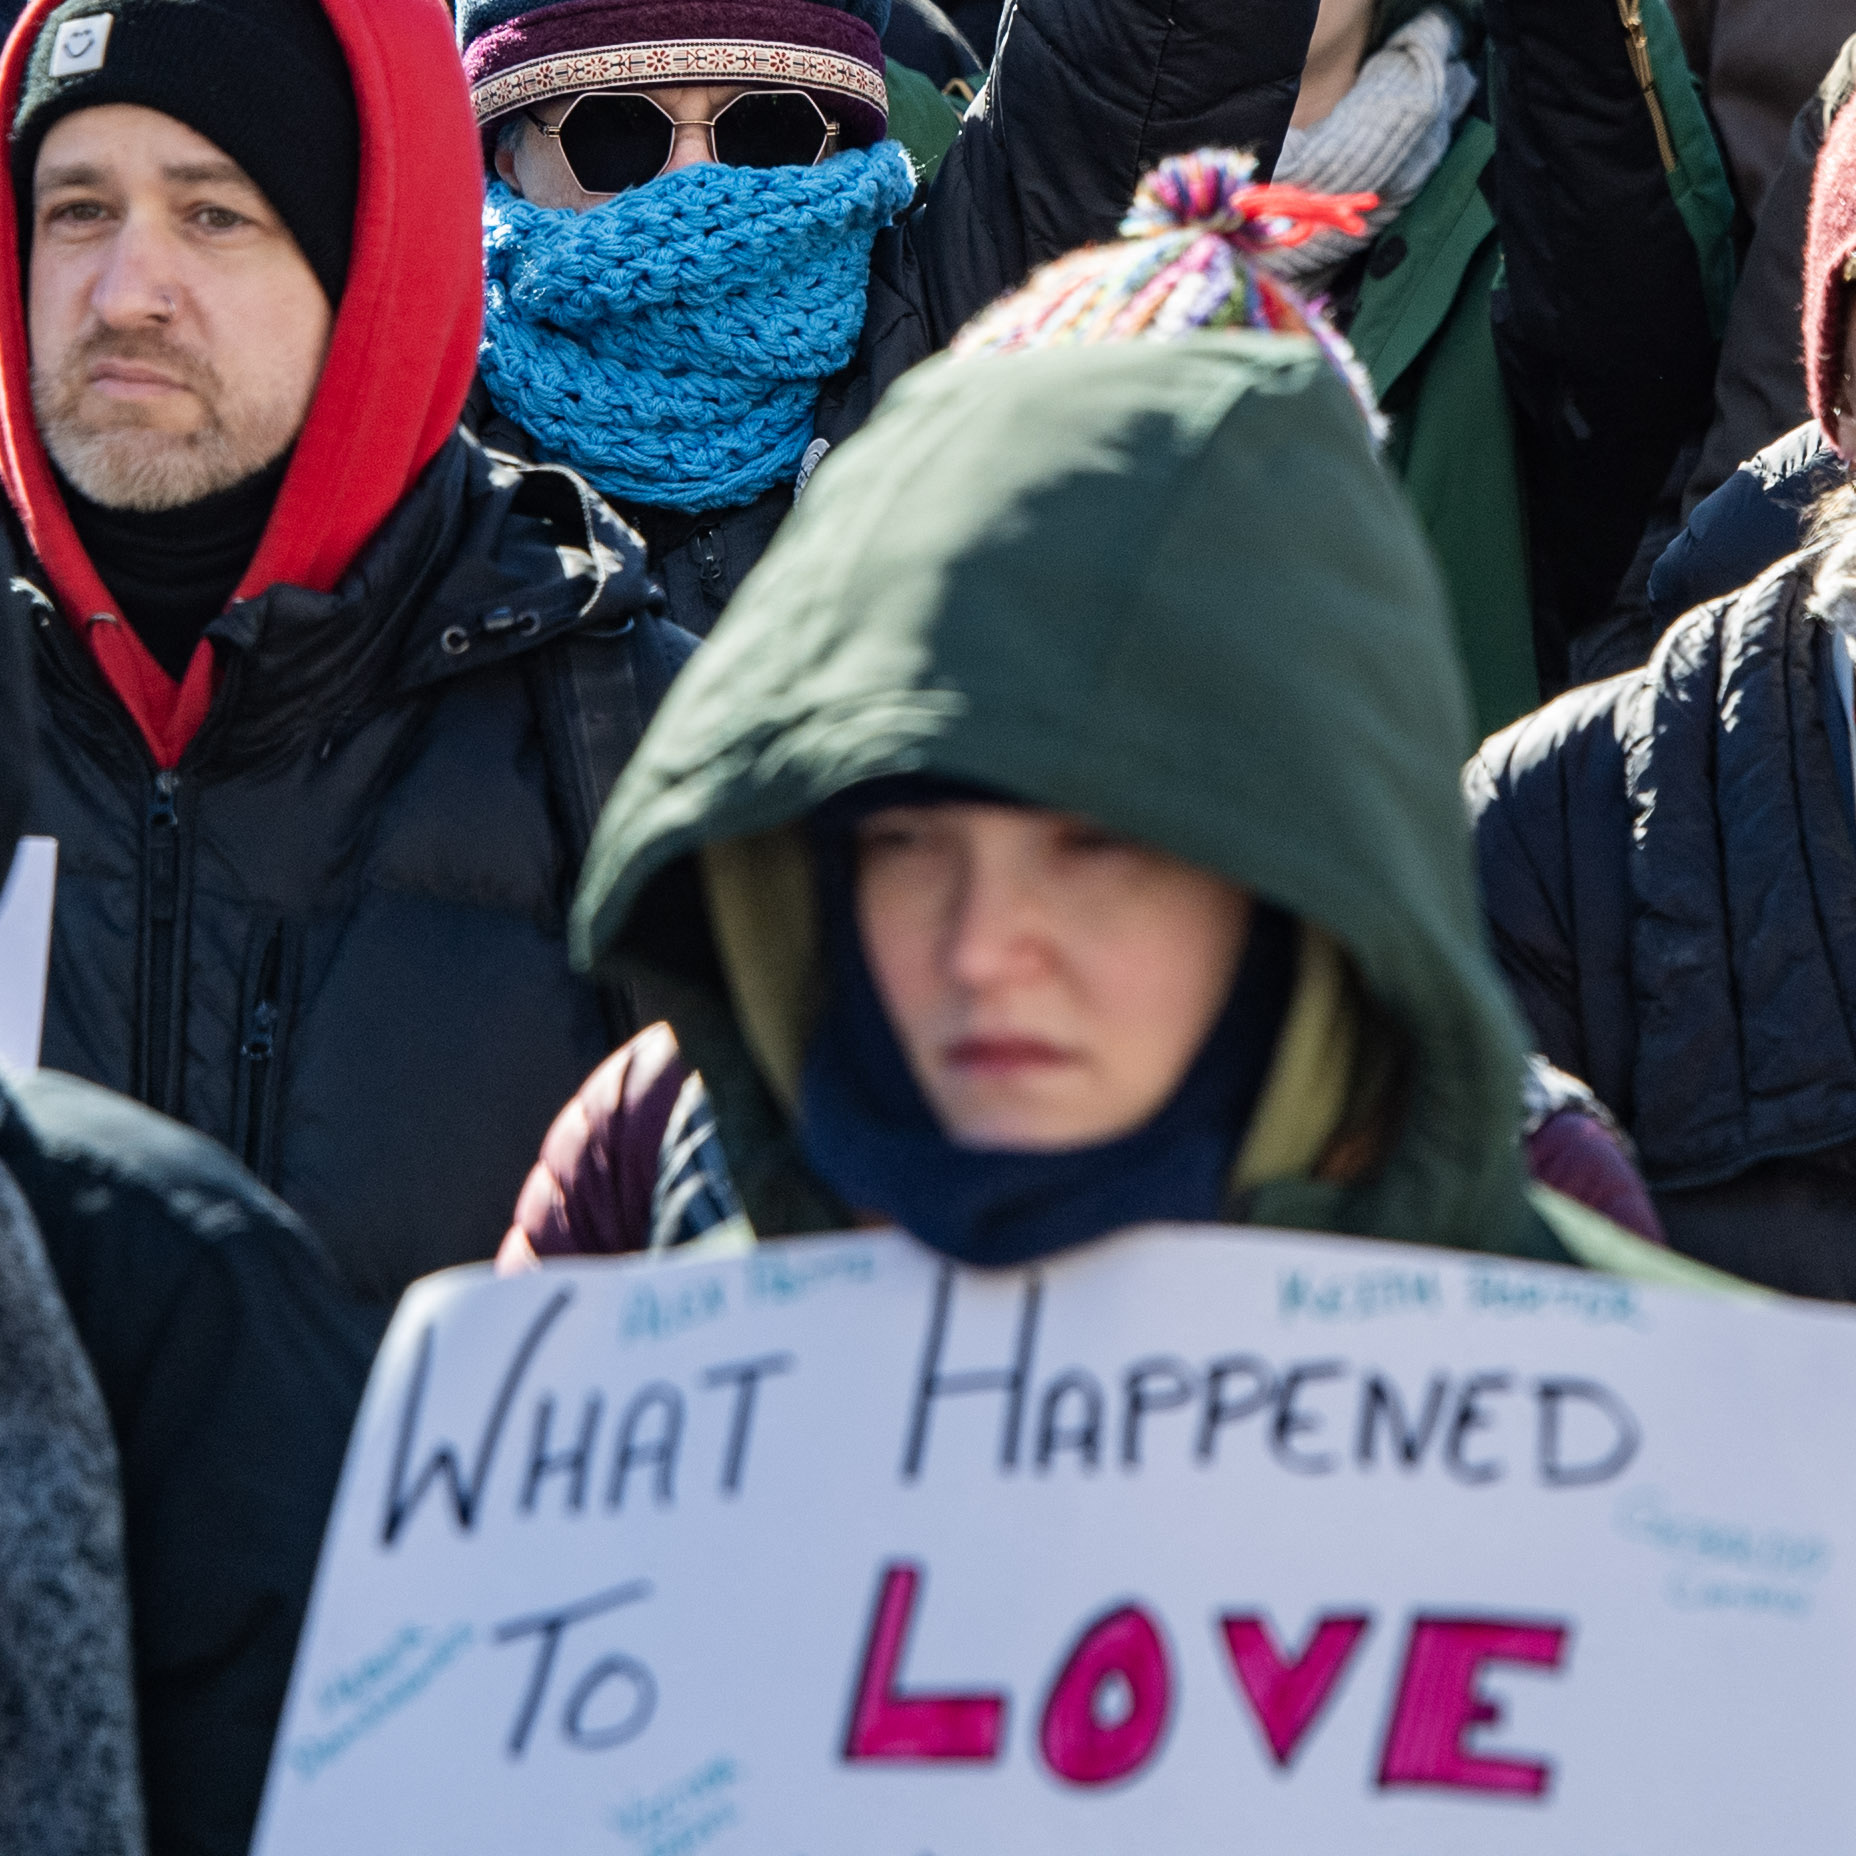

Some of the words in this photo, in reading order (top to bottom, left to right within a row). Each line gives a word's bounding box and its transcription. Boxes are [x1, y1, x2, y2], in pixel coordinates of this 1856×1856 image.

[380, 1282, 794, 1546] WHAT
[901, 1259, 1643, 1490] HAPPENED
[492, 1576, 660, 1759] TO
[838, 1558, 1574, 1800] LOVE
